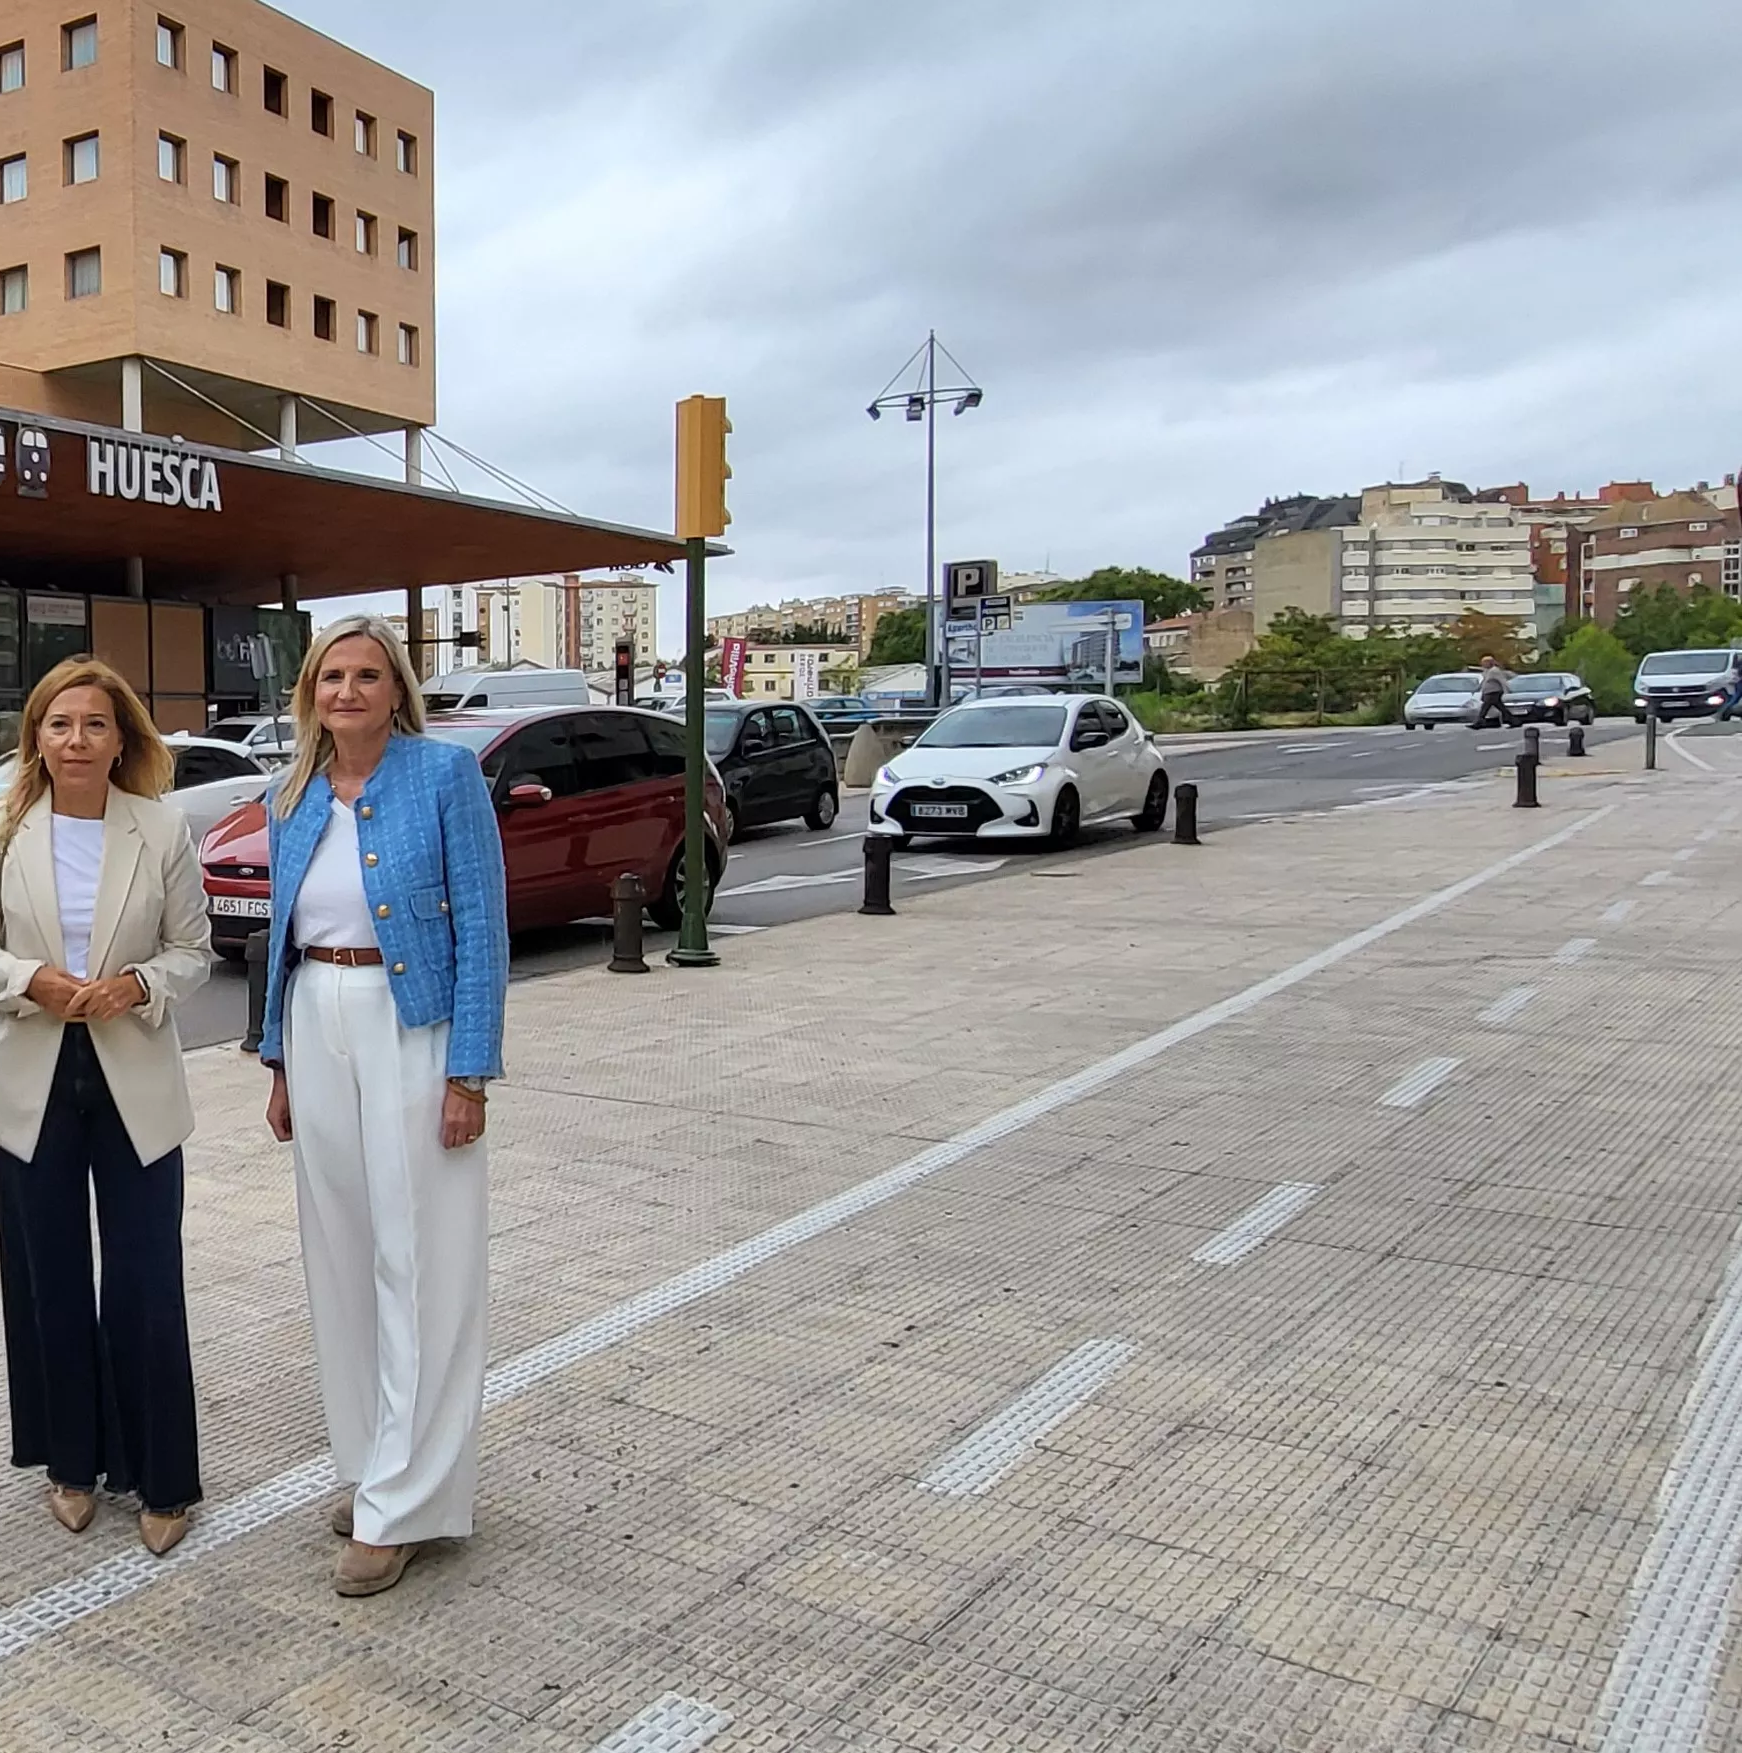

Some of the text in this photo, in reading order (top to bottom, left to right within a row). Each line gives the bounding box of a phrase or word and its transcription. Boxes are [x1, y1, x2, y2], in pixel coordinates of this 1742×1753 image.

[89, 441, 222, 512] HUESCA
[959, 568, 980, 596] P
[217, 899, 269, 916] 4651 FCS
